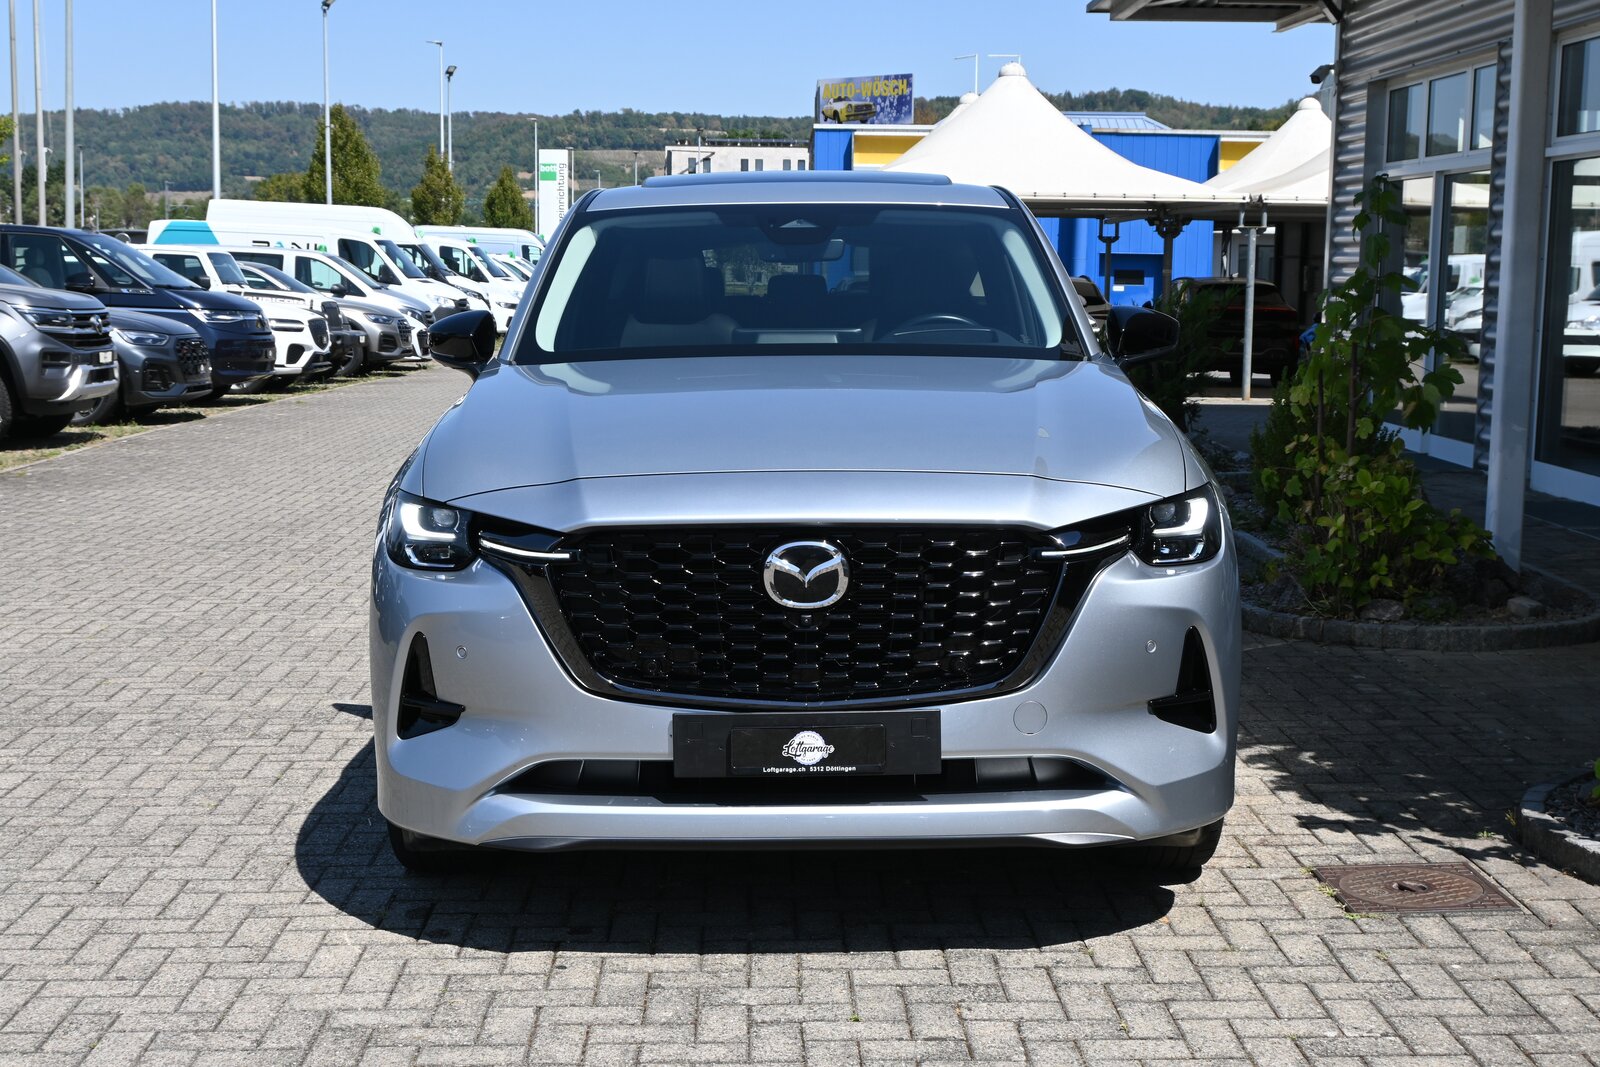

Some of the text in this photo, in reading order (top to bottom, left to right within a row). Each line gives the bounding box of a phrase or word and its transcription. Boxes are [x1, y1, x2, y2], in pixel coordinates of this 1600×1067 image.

[822, 77, 907, 99] AUTO-WÖSCH
[556, 163, 568, 221] einrichtung
[782, 739, 835, 759] Loftgarage
